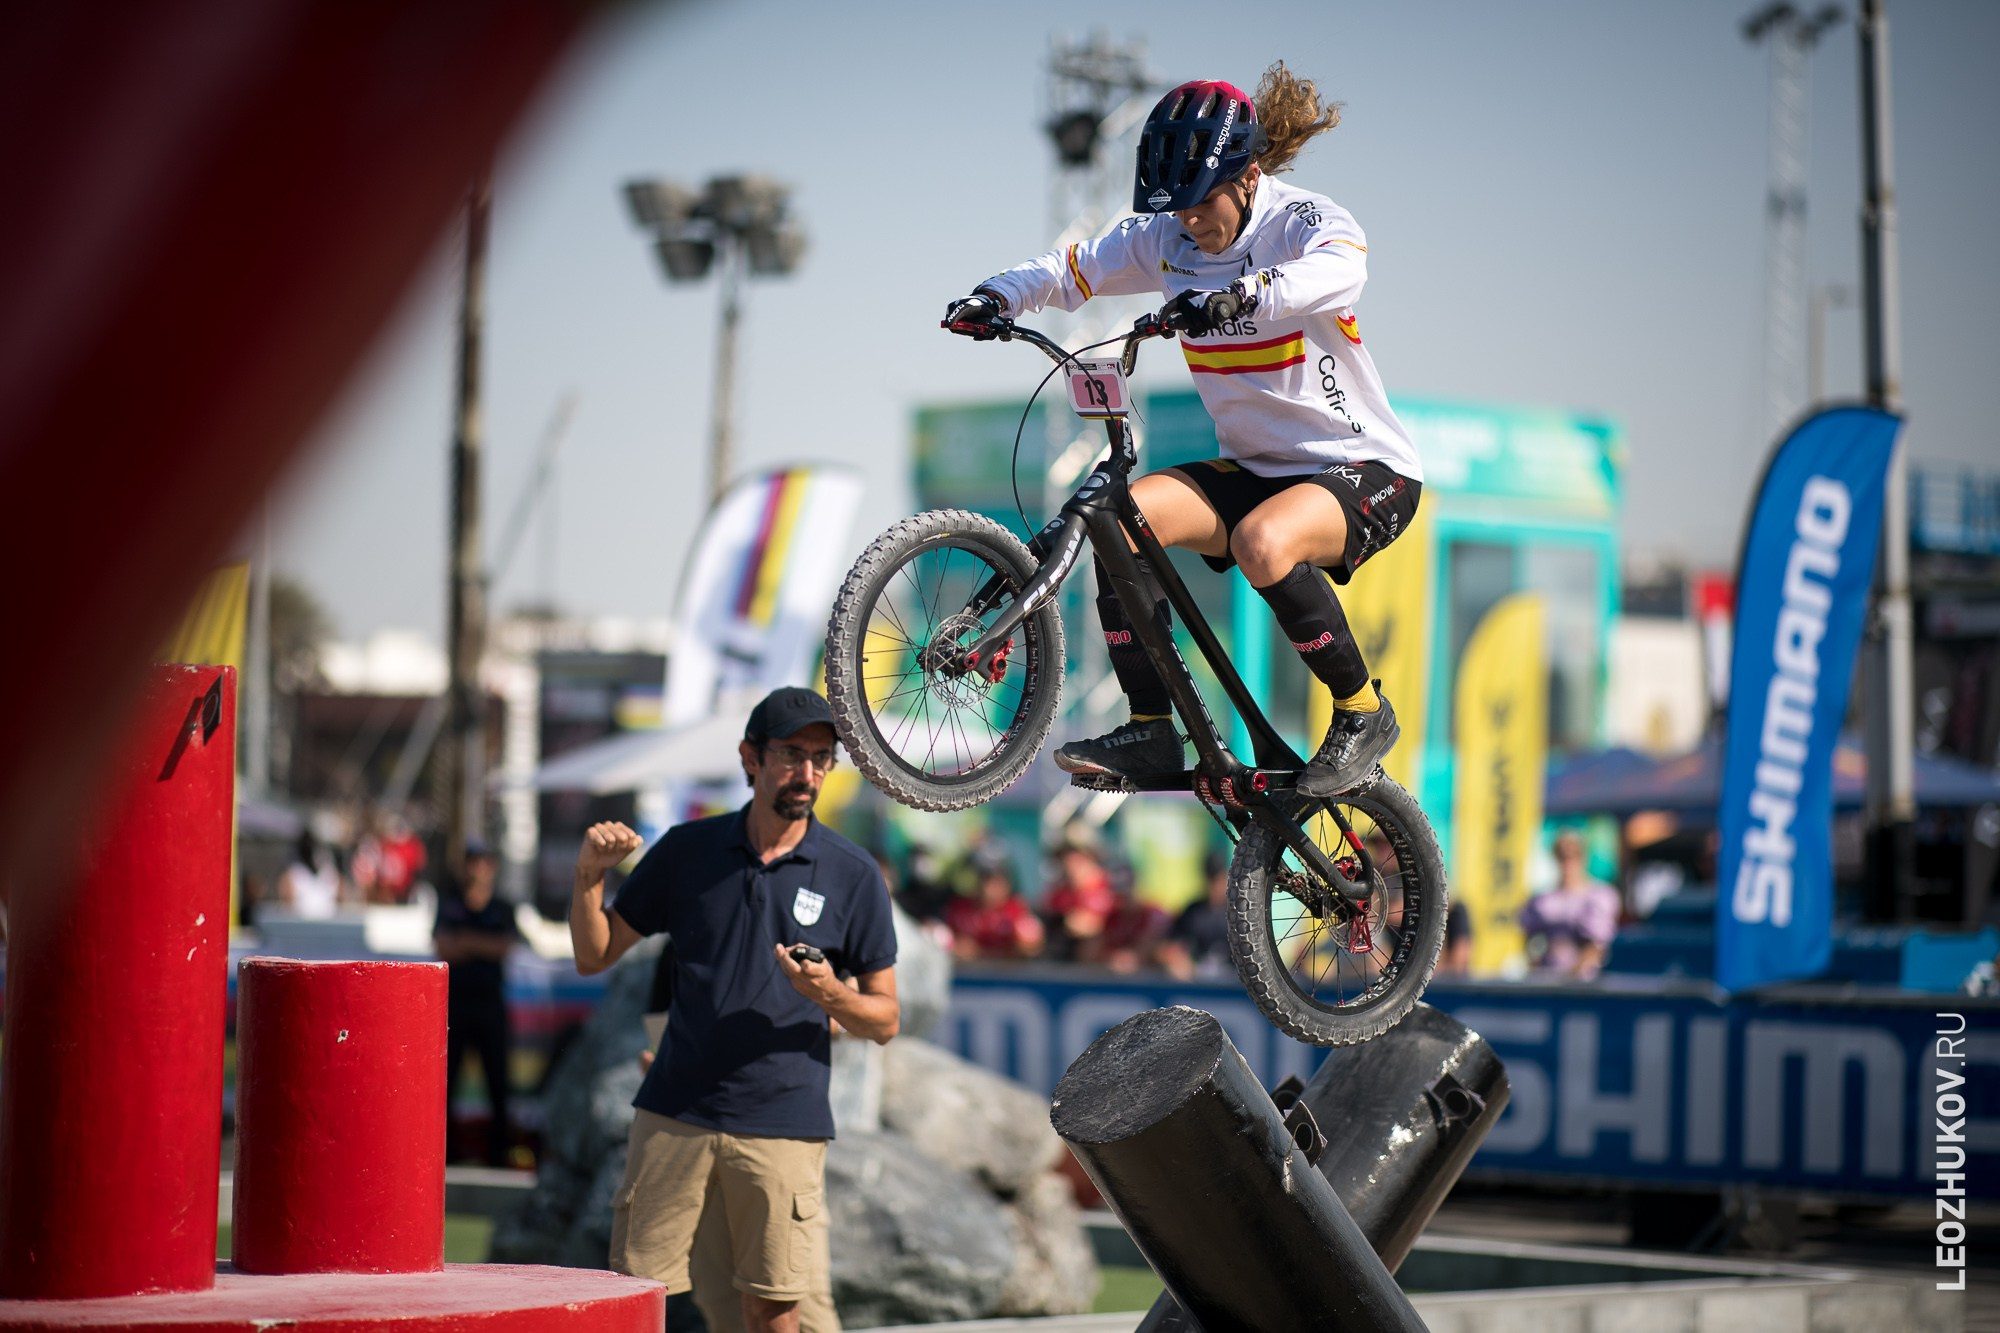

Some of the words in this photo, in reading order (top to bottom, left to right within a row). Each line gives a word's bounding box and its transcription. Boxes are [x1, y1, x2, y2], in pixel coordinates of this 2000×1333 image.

[1213, 98, 1238, 155] BASQUELAND
[1084, 379, 1109, 405] 13
[1732, 475, 1852, 928] SHIMANO
